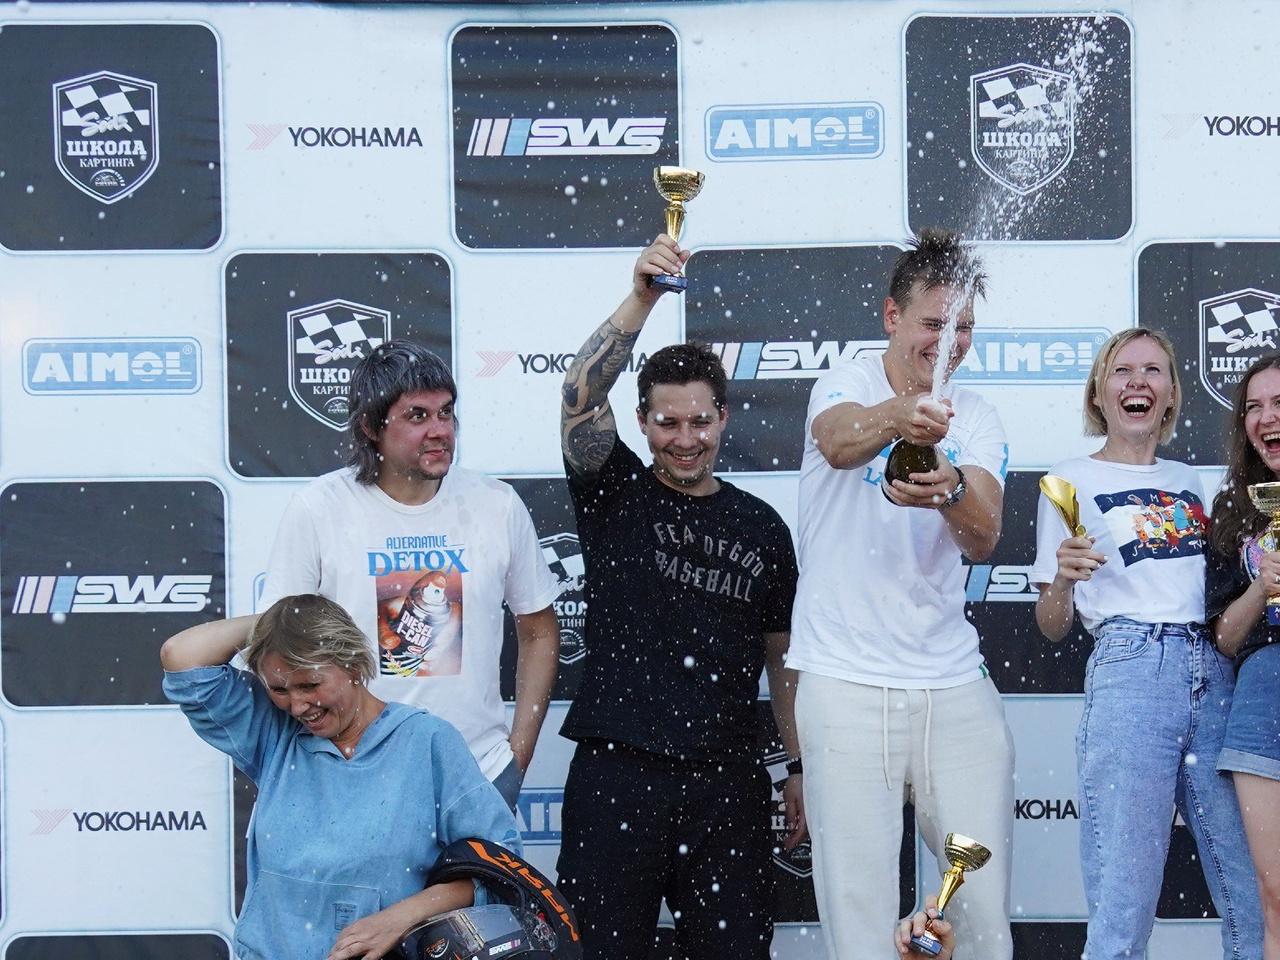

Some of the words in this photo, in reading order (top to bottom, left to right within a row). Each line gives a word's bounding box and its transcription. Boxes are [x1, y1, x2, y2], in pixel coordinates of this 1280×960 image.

[288, 126, 423, 148] YOKOHAMA
[525, 117, 667, 156] SWS
[714, 116, 875, 149] AIMOL
[983, 132, 1062, 147] ШКОЛА
[66, 140, 147, 156] ШКОЛА
[80, 158, 135, 168] КАРТИНГА
[32, 352, 193, 383] AIMOL
[300, 368, 354, 383] ШКО
[313, 385, 351, 395] КАРТИ
[386, 535, 447, 549] ALTERNATIVE
[653, 522, 695, 545] FEA
[367, 548, 469, 577] DETOX
[74, 575, 212, 613] SWS
[400, 611, 434, 638] DIESEL
[73, 810, 207, 832] YOKOHAMA
